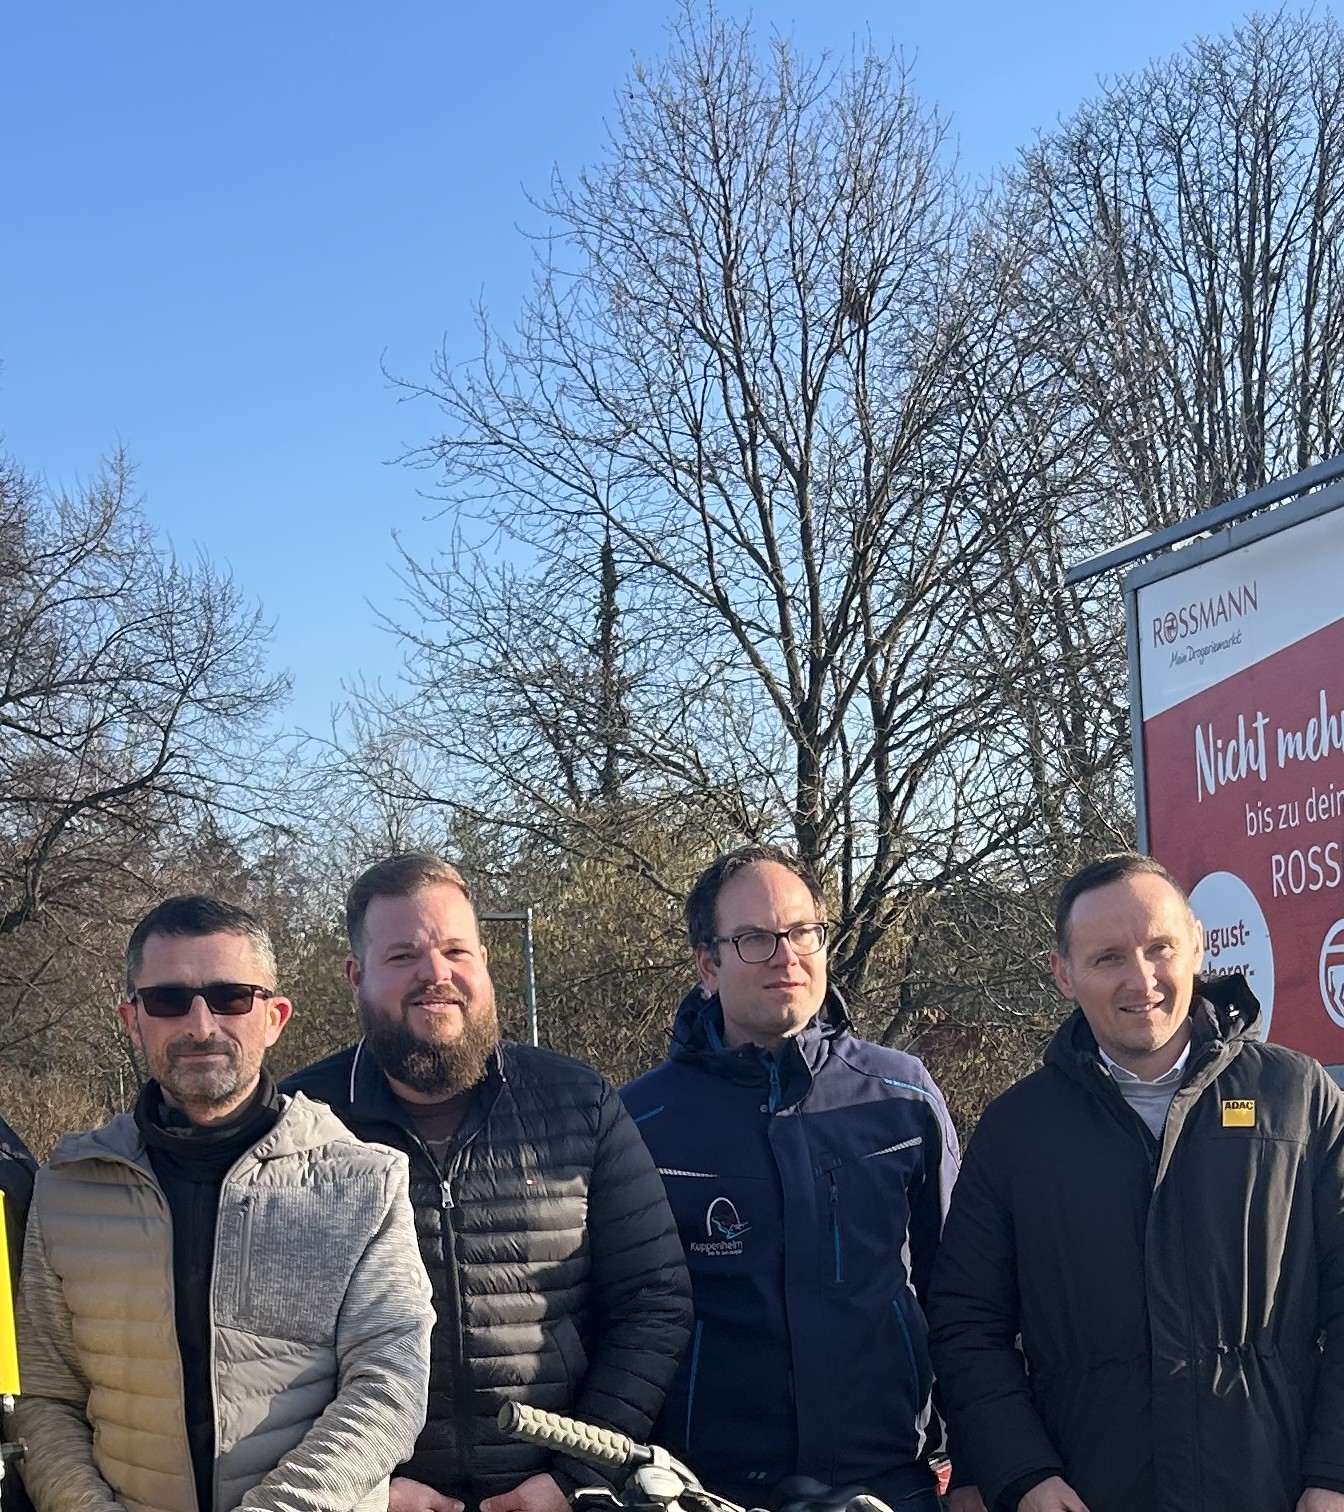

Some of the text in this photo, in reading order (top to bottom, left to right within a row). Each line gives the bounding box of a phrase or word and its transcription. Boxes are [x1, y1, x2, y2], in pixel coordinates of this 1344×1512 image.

[1153, 580, 1257, 648] ROSSMANN
[1169, 628, 1242, 668] Mein Drogeriemarkt
[1195, 711, 1270, 802] Nicht
[1245, 800, 1273, 837] bis
[1278, 801, 1299, 829] zu
[1203, 919, 1250, 957] ugust-
[1225, 1101, 1253, 1110] ADAC
